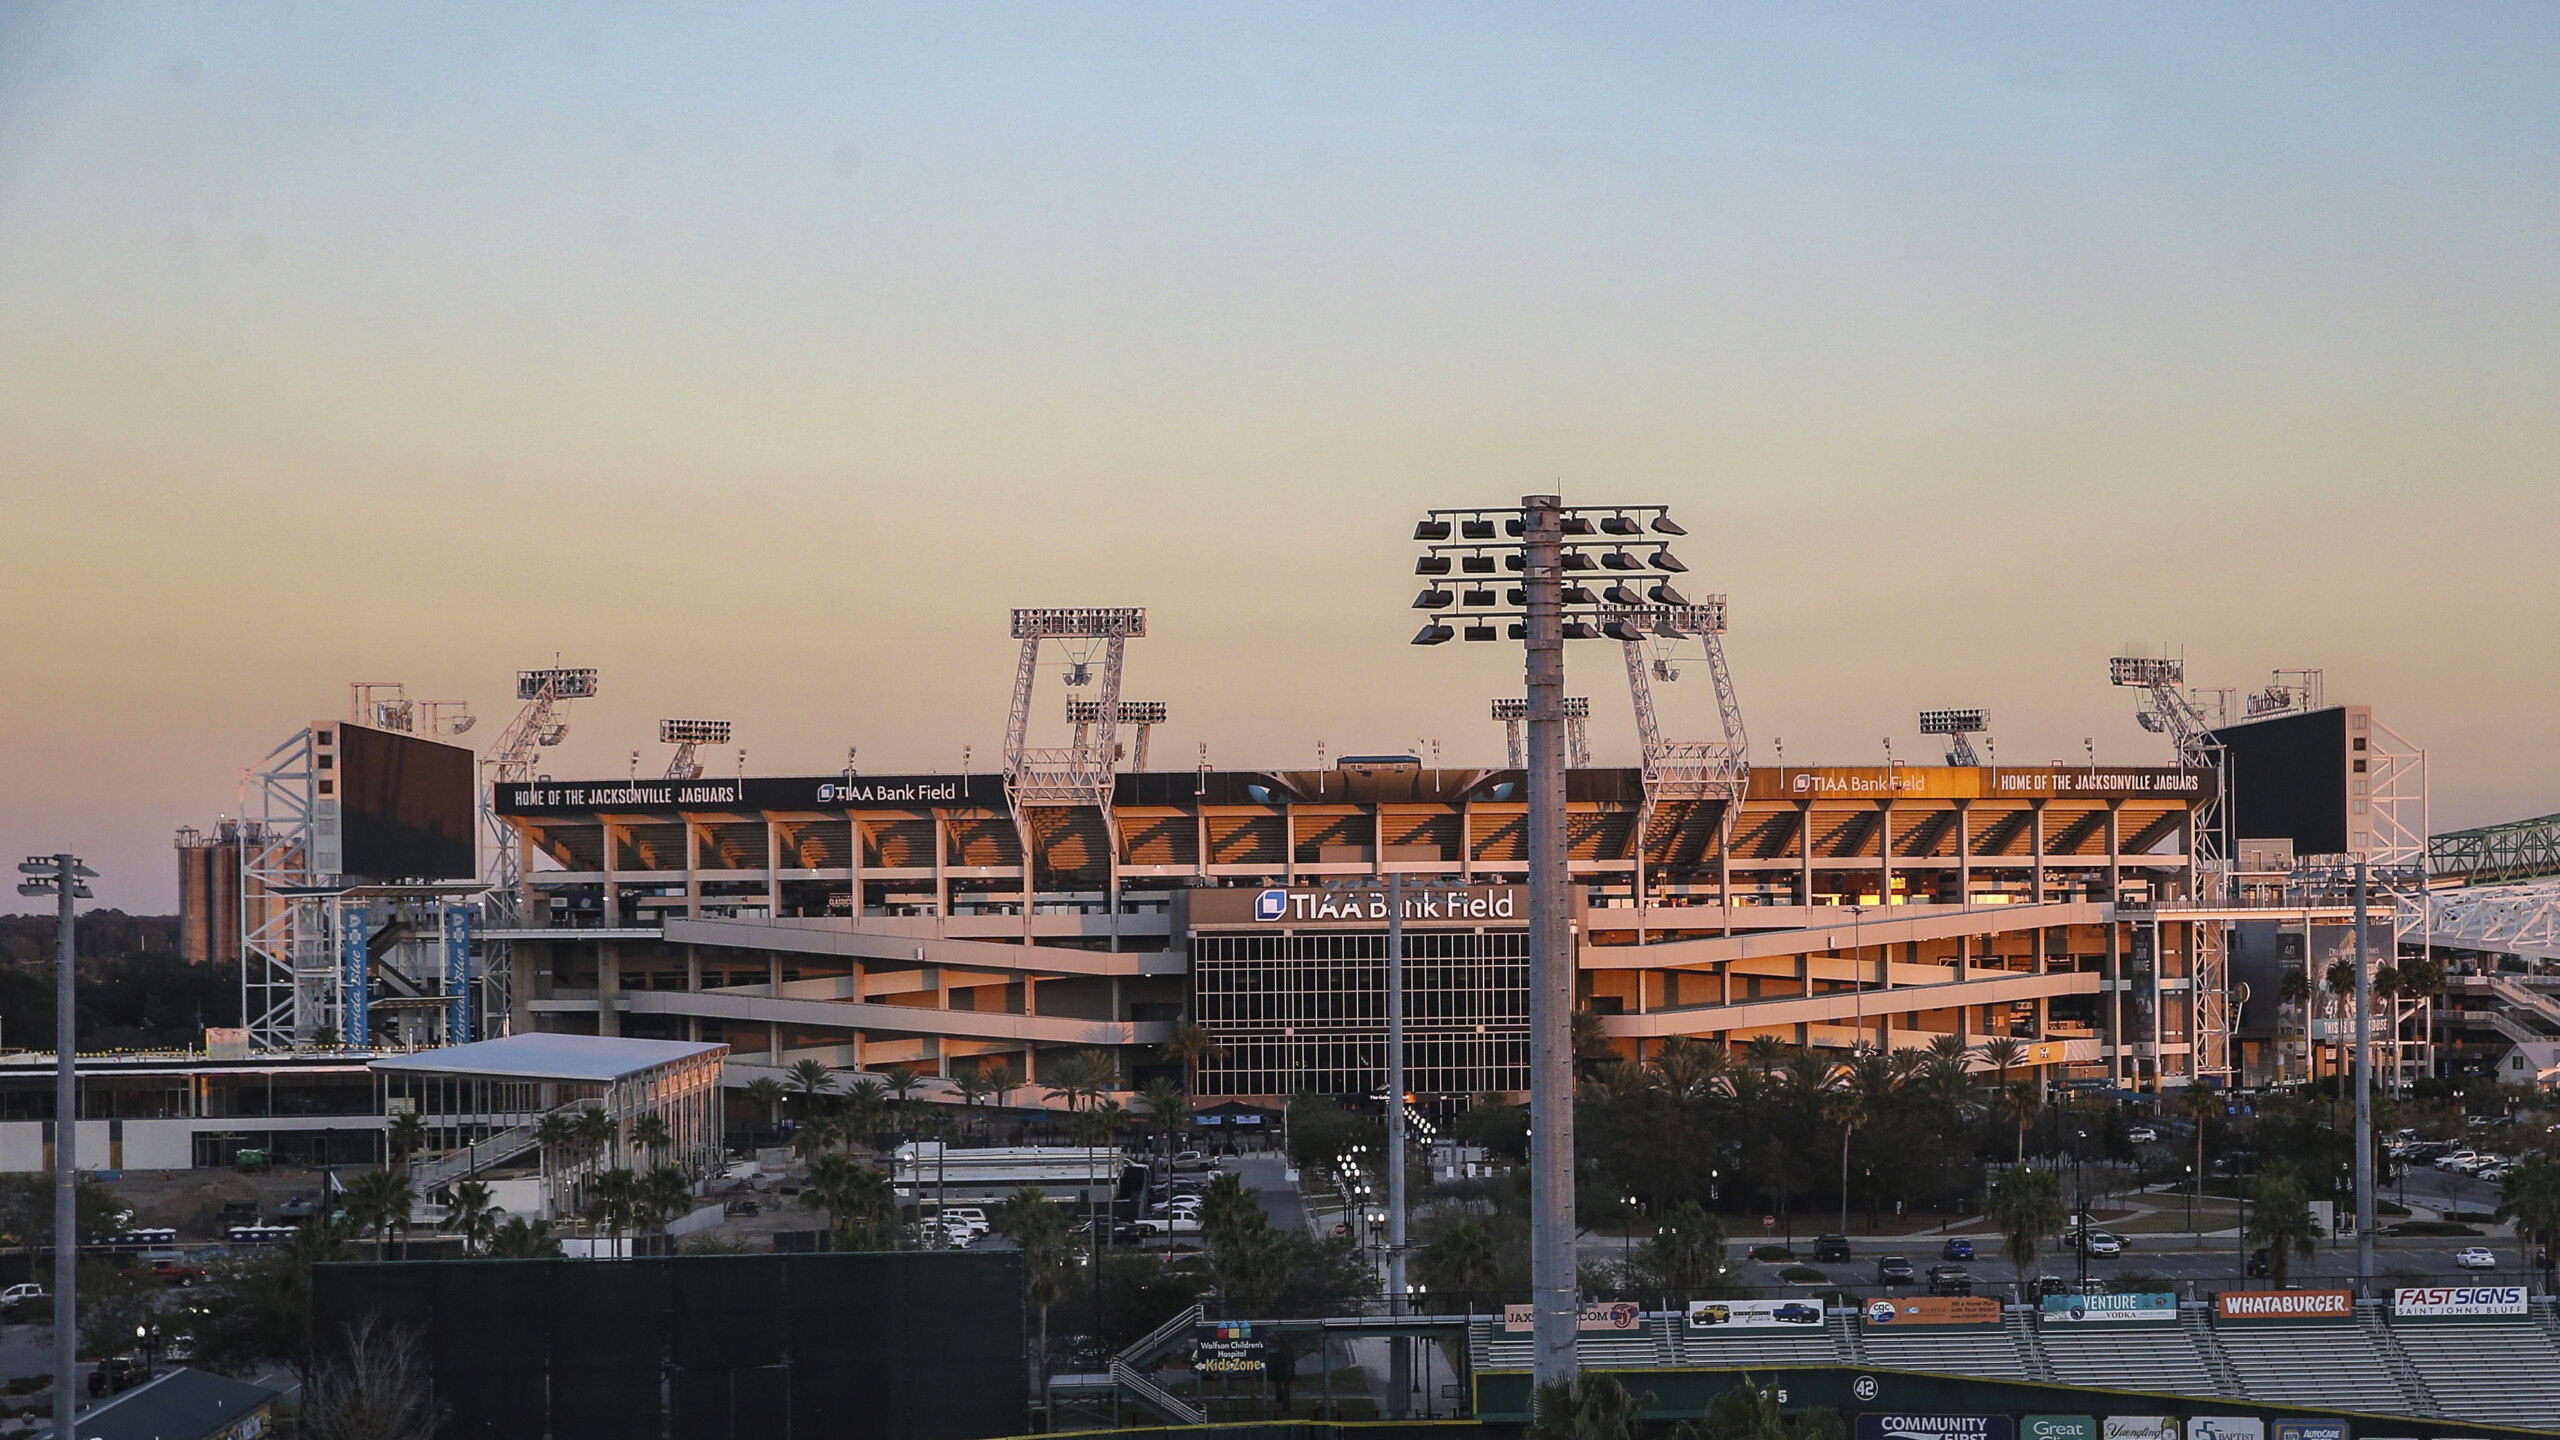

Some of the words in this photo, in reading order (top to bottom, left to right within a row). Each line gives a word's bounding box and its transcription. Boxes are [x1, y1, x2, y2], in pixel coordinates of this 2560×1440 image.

[1811, 776, 1847, 791] TIAA
[1852, 775, 1887, 791] Bank
[1891, 775, 1925, 791] Field
[2001, 774, 2031, 790] HOME
[2034, 774, 2047, 790] OF
[2052, 774, 2072, 790] THE
[2075, 774, 2150, 790] JACKSONVILLE
[2154, 774, 2198, 790] JAGUARS
[515, 789, 544, 806] HOME
[549, 789, 561, 805] OF
[565, 789, 585, 805] THE
[589, 787, 671, 805] JACKSONVILLE
[678, 786, 734, 803] JAGUARS
[835, 785, 873, 801] TIAA
[877, 784, 915, 800] Bank
[918, 783, 955, 800] Field
[1289, 893, 1363, 919] TIAA
[1447, 889, 1514, 918] Field
[350, 950, 362, 987] Blue
[454, 948, 466, 985] Blue
[2324, 1022, 2338, 1034] THIS
[2083, 1295, 2137, 1309] VENTURE
[2225, 1295, 2345, 1314] WHATABURGER
[2399, 1288, 2520, 1305] FASTSIGNS
[2399, 1307, 2435, 1315] SAINT
[2440, 1306, 2480, 1314] JOHNS
[1230, 1340, 1264, 1349] Children's
[1217, 1349, 1247, 1359] Hospital
[1856, 1380, 1874, 1396] 42
[1881, 1416, 1987, 1431] COMMUNITY
[2033, 1421, 2083, 1435] Great
[2105, 1423, 2162, 1439] Yuengling
